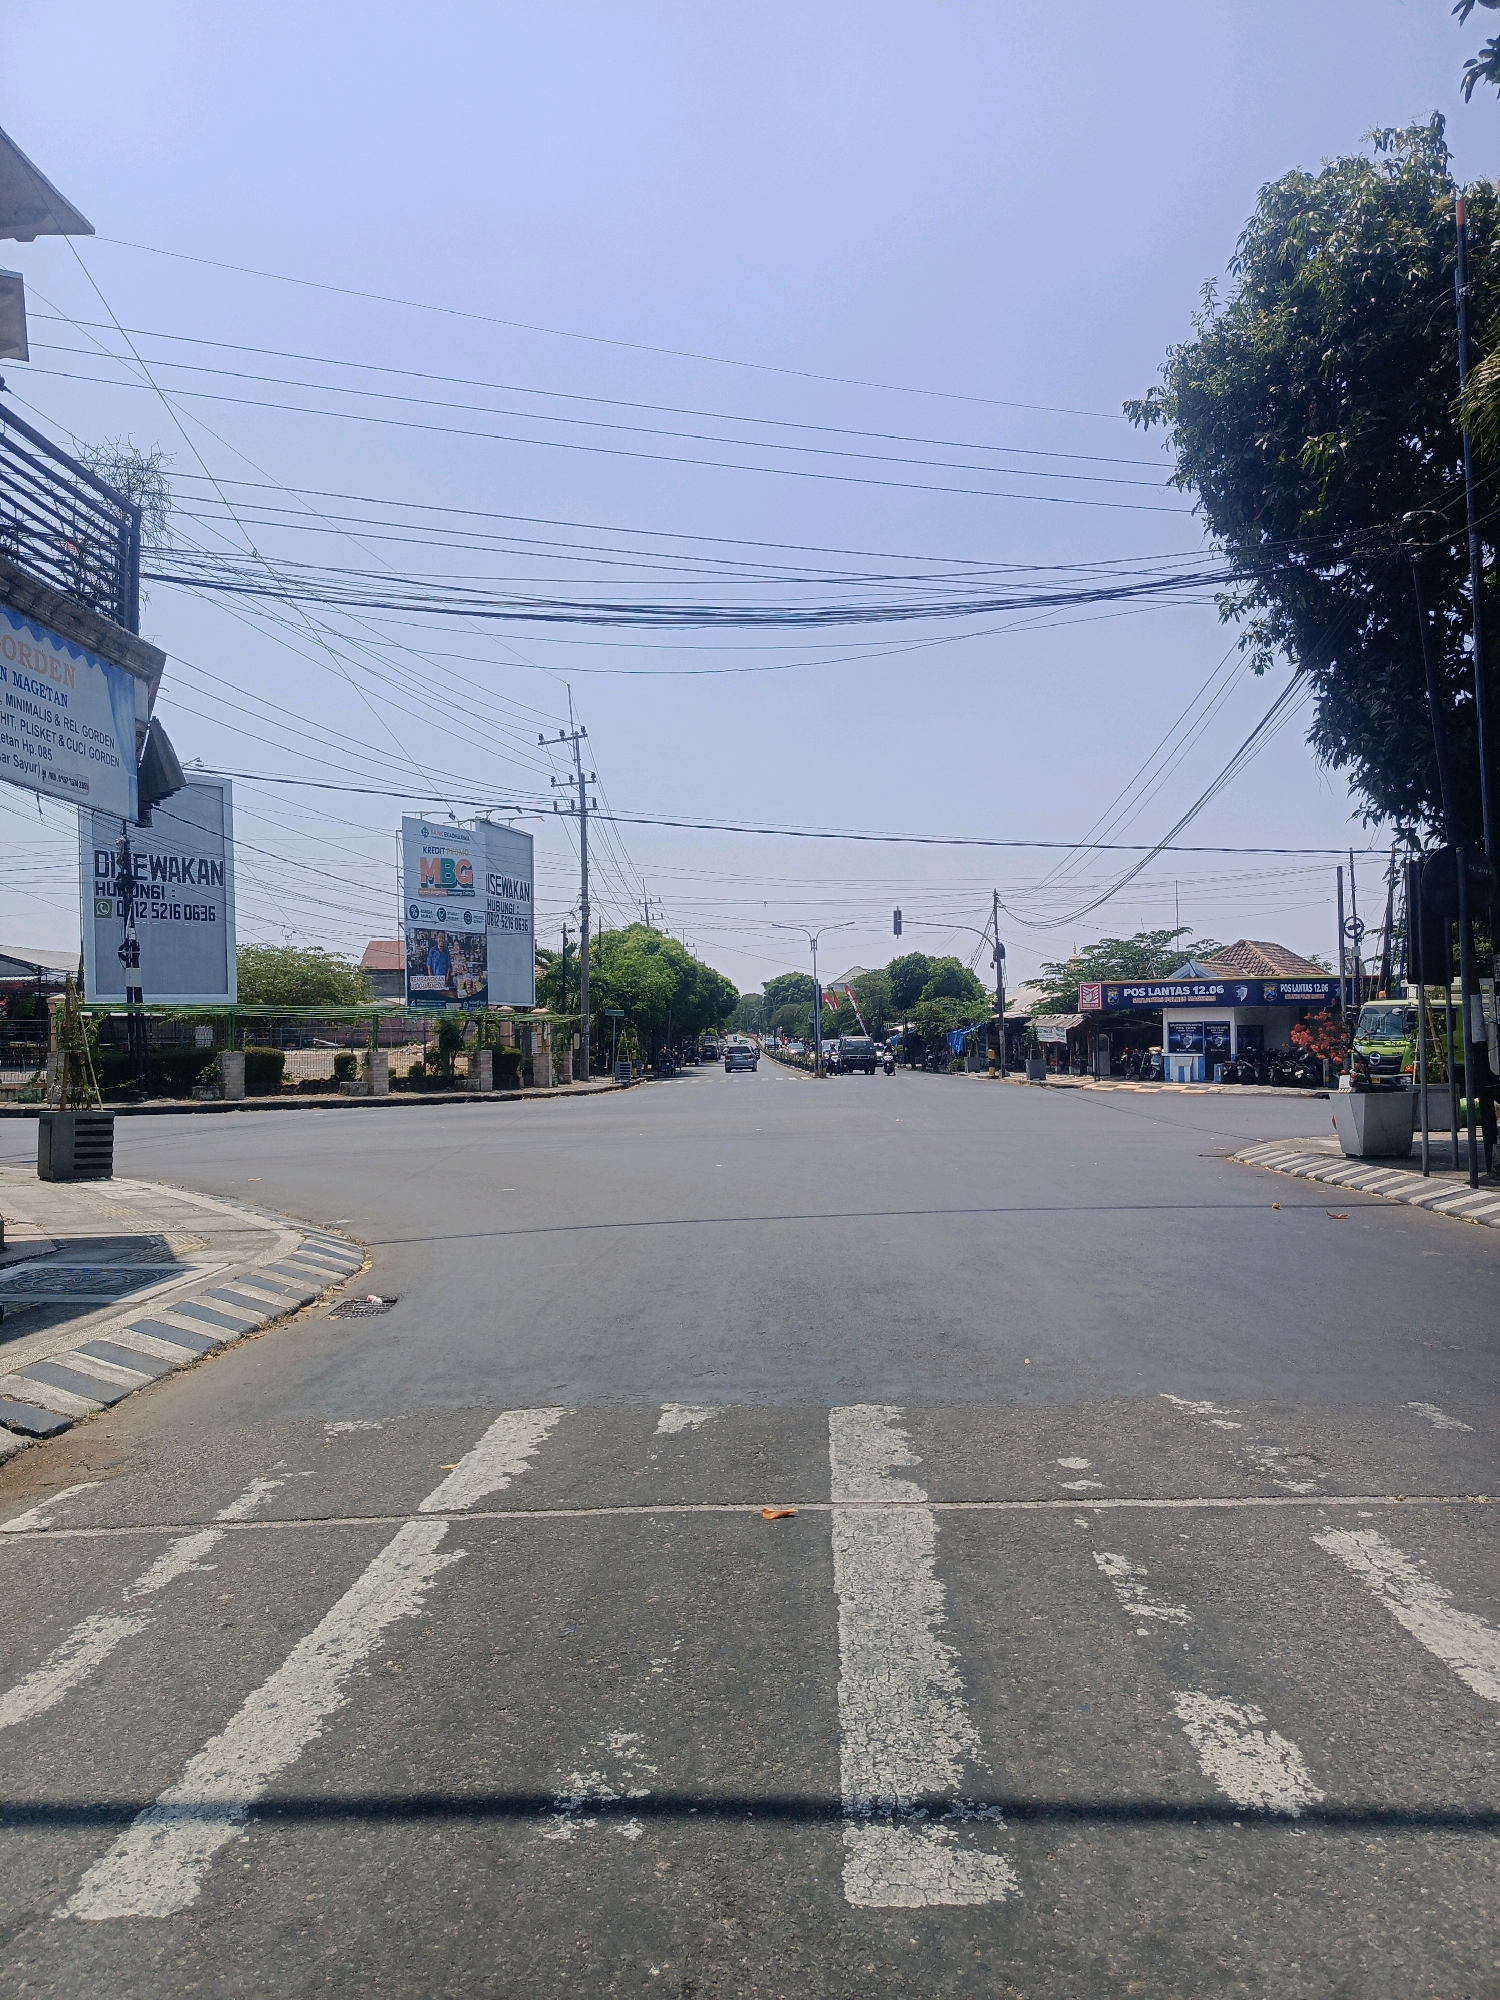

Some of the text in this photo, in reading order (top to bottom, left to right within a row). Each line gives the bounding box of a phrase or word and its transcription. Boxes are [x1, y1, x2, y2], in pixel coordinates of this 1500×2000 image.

[0, 634, 76, 690] ORDEN
[12, 670, 68, 708] MAGETAN
[5, 692, 115, 749] MINIMALIS & REL GORDEN
[0, 732, 20, 749] etan
[20, 718, 57, 745] PLISKET
[58, 734, 65, 747] &
[66, 737, 87, 757] CUCI
[88, 746, 120, 769] GORDEN
[0, 752, 41, 779] ar Sayur)
[422, 846, 446, 855] KREDIT
[94, 850, 224, 887] DIEWAKAN
[419, 856, 474, 889] MBG
[95, 880, 165, 900] HUUNGI
[116, 900, 216, 922] 012 5216 0636
[486, 898, 516, 915] HUBUNGI
[1123, 985, 1225, 997] POS LANTAS 12.06
[1280, 983, 1329, 993] POS LANTAS 12.06
